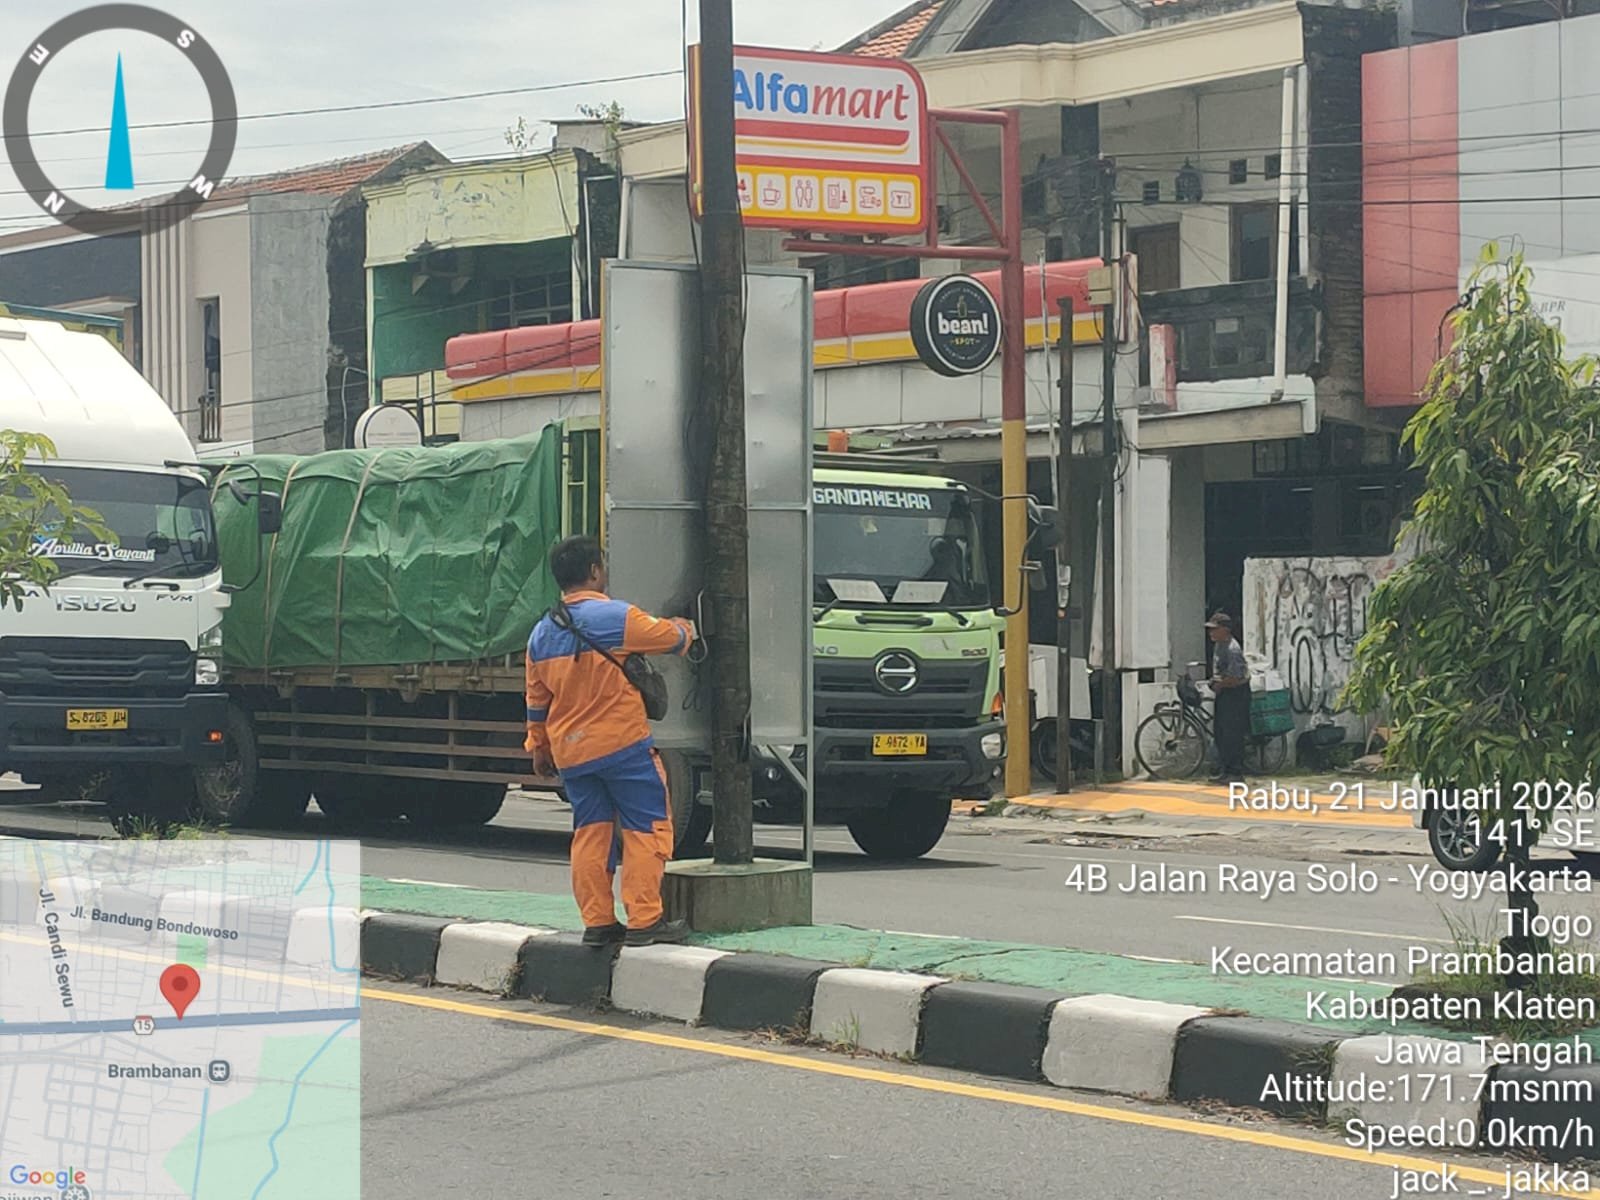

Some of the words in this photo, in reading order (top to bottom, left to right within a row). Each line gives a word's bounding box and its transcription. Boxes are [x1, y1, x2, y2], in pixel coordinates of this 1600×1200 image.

[733, 69, 910, 120] Alfamart
[938, 312, 989, 335] bean!
[56, 595, 136, 612] ISUZU
[156, 594, 193, 602] FVM
